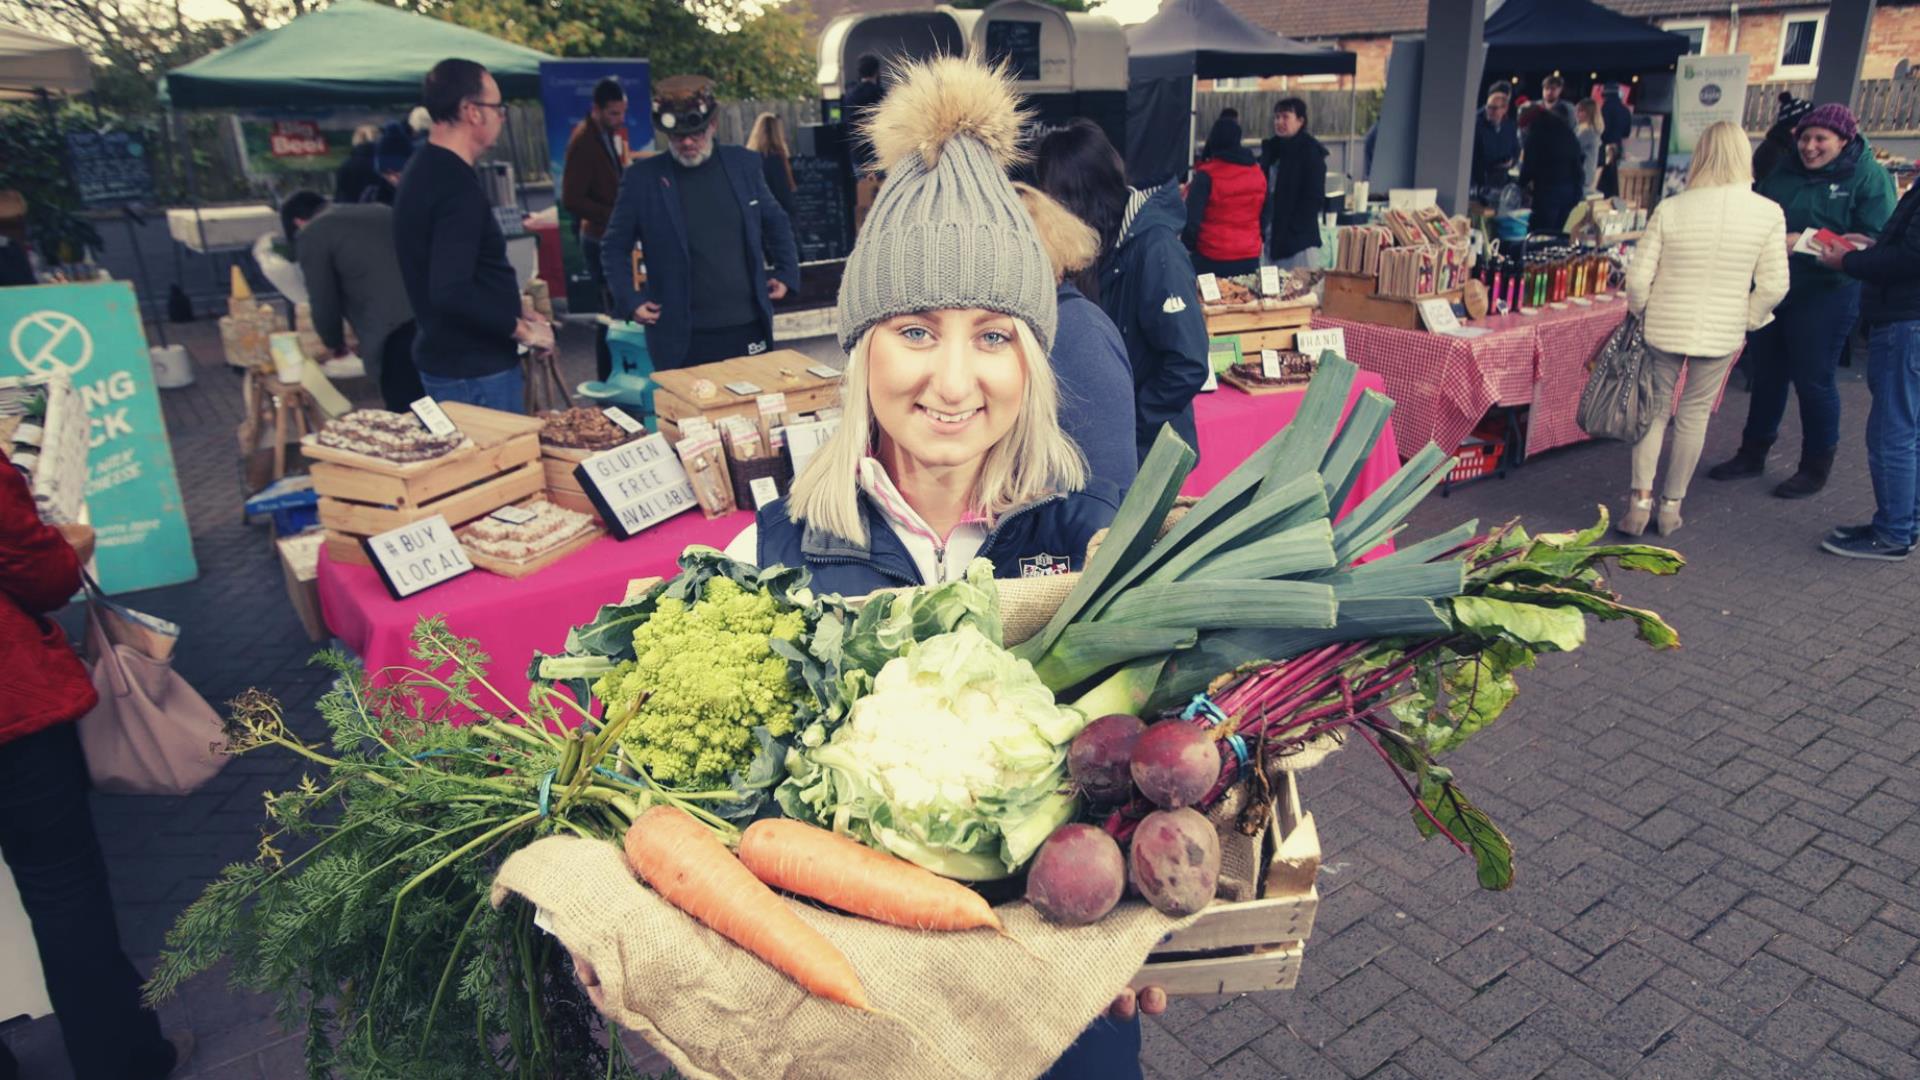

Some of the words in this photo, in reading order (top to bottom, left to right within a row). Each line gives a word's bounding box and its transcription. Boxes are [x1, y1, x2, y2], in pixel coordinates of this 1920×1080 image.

[596, 443, 659, 477] GLUTEN
[618, 469, 662, 498] FREE
[396, 548, 463, 587] LOCAL
